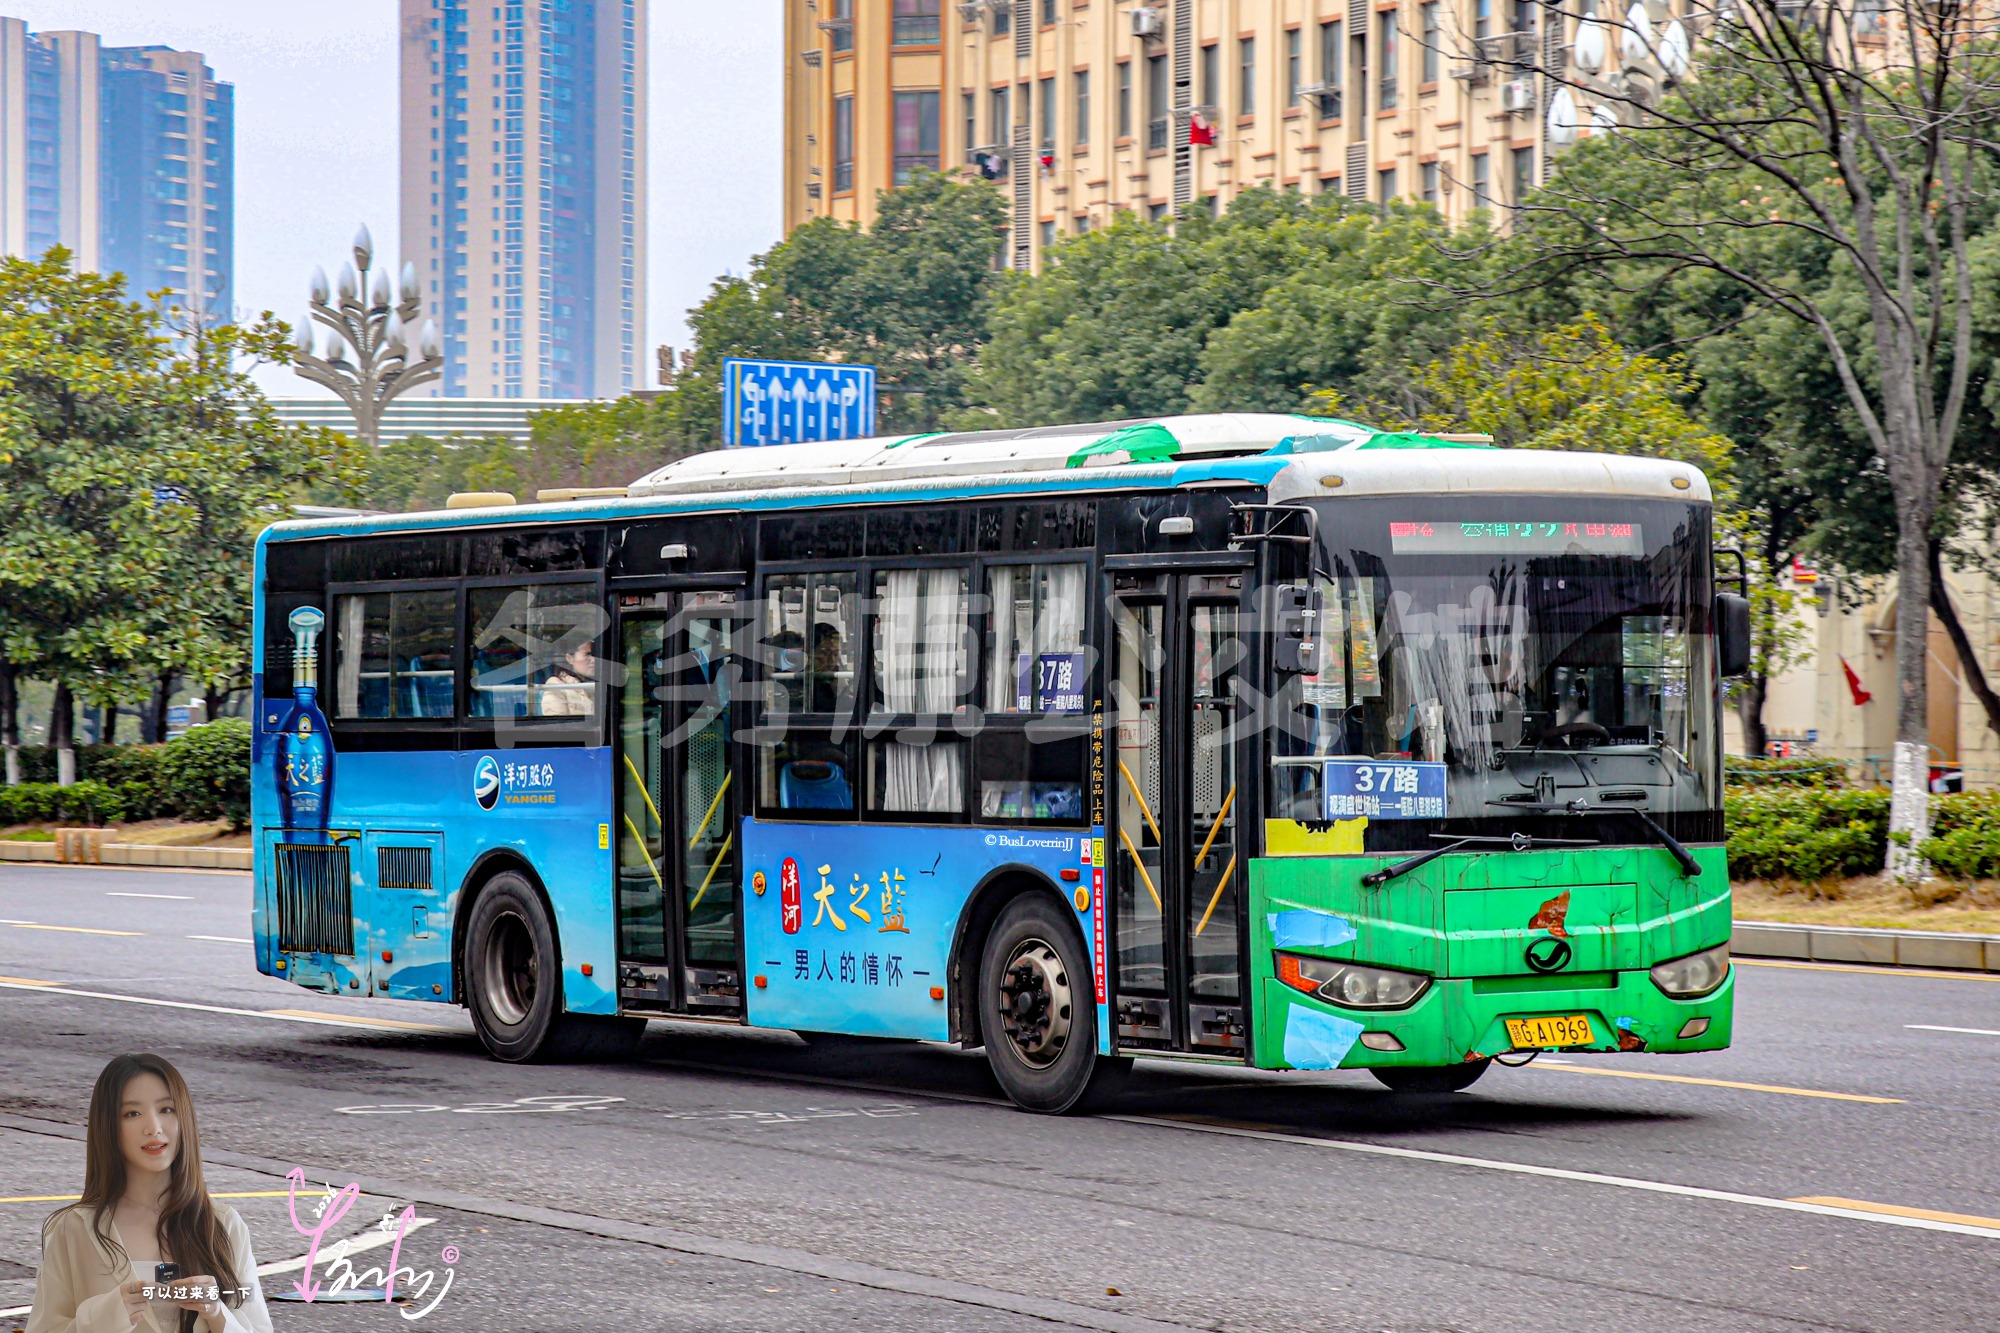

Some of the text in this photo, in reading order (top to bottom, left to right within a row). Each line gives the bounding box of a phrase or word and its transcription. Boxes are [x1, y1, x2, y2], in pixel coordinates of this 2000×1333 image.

[503, 762, 554, 791] 洋河股份
[1091, 699, 1104, 825] 严禁携带危险品上车
[1355, 766, 1419, 794] 37路
[504, 794, 556, 803] YANGHE
[781, 862, 801, 933] 洋河
